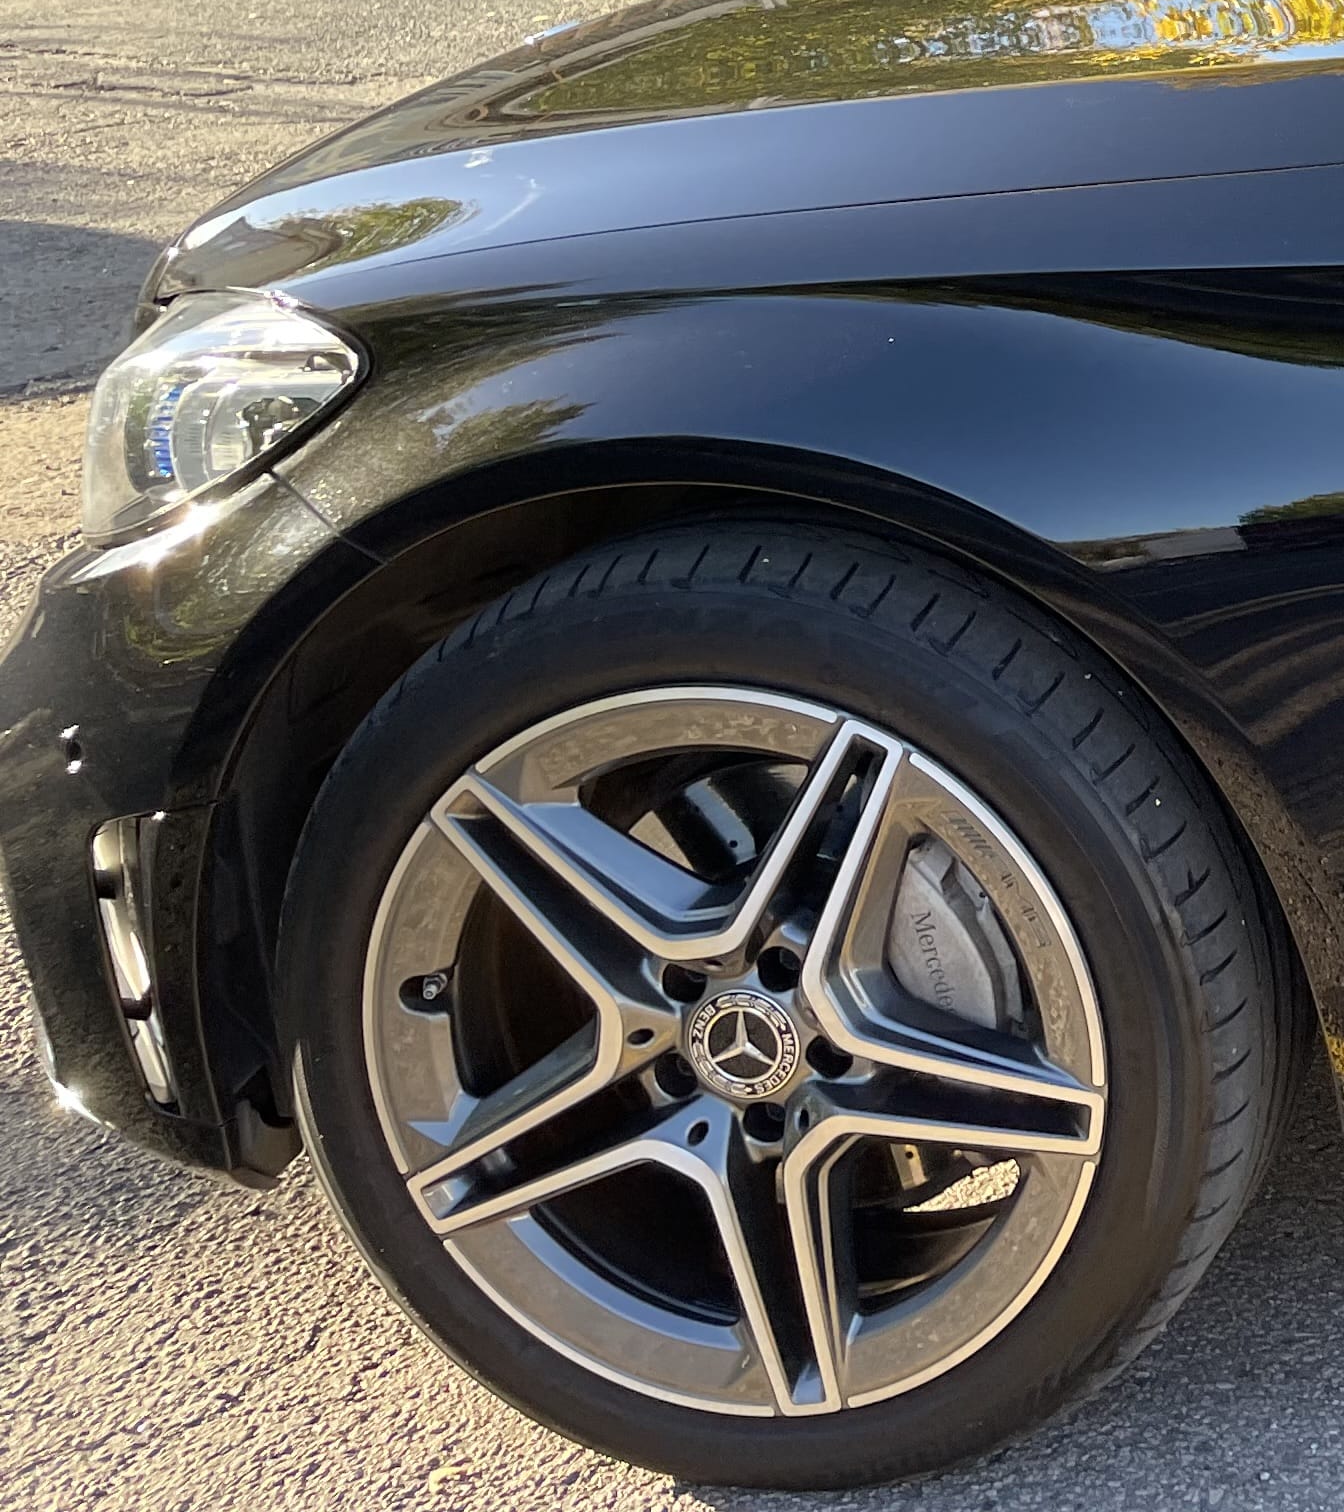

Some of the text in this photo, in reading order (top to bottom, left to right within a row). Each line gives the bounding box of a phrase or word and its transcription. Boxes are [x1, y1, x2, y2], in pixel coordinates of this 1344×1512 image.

[911, 911, 956, 1013] Mercede
[692, 1003, 716, 1040] BENZ
[753, 1033, 795, 1094] MERCEDES
